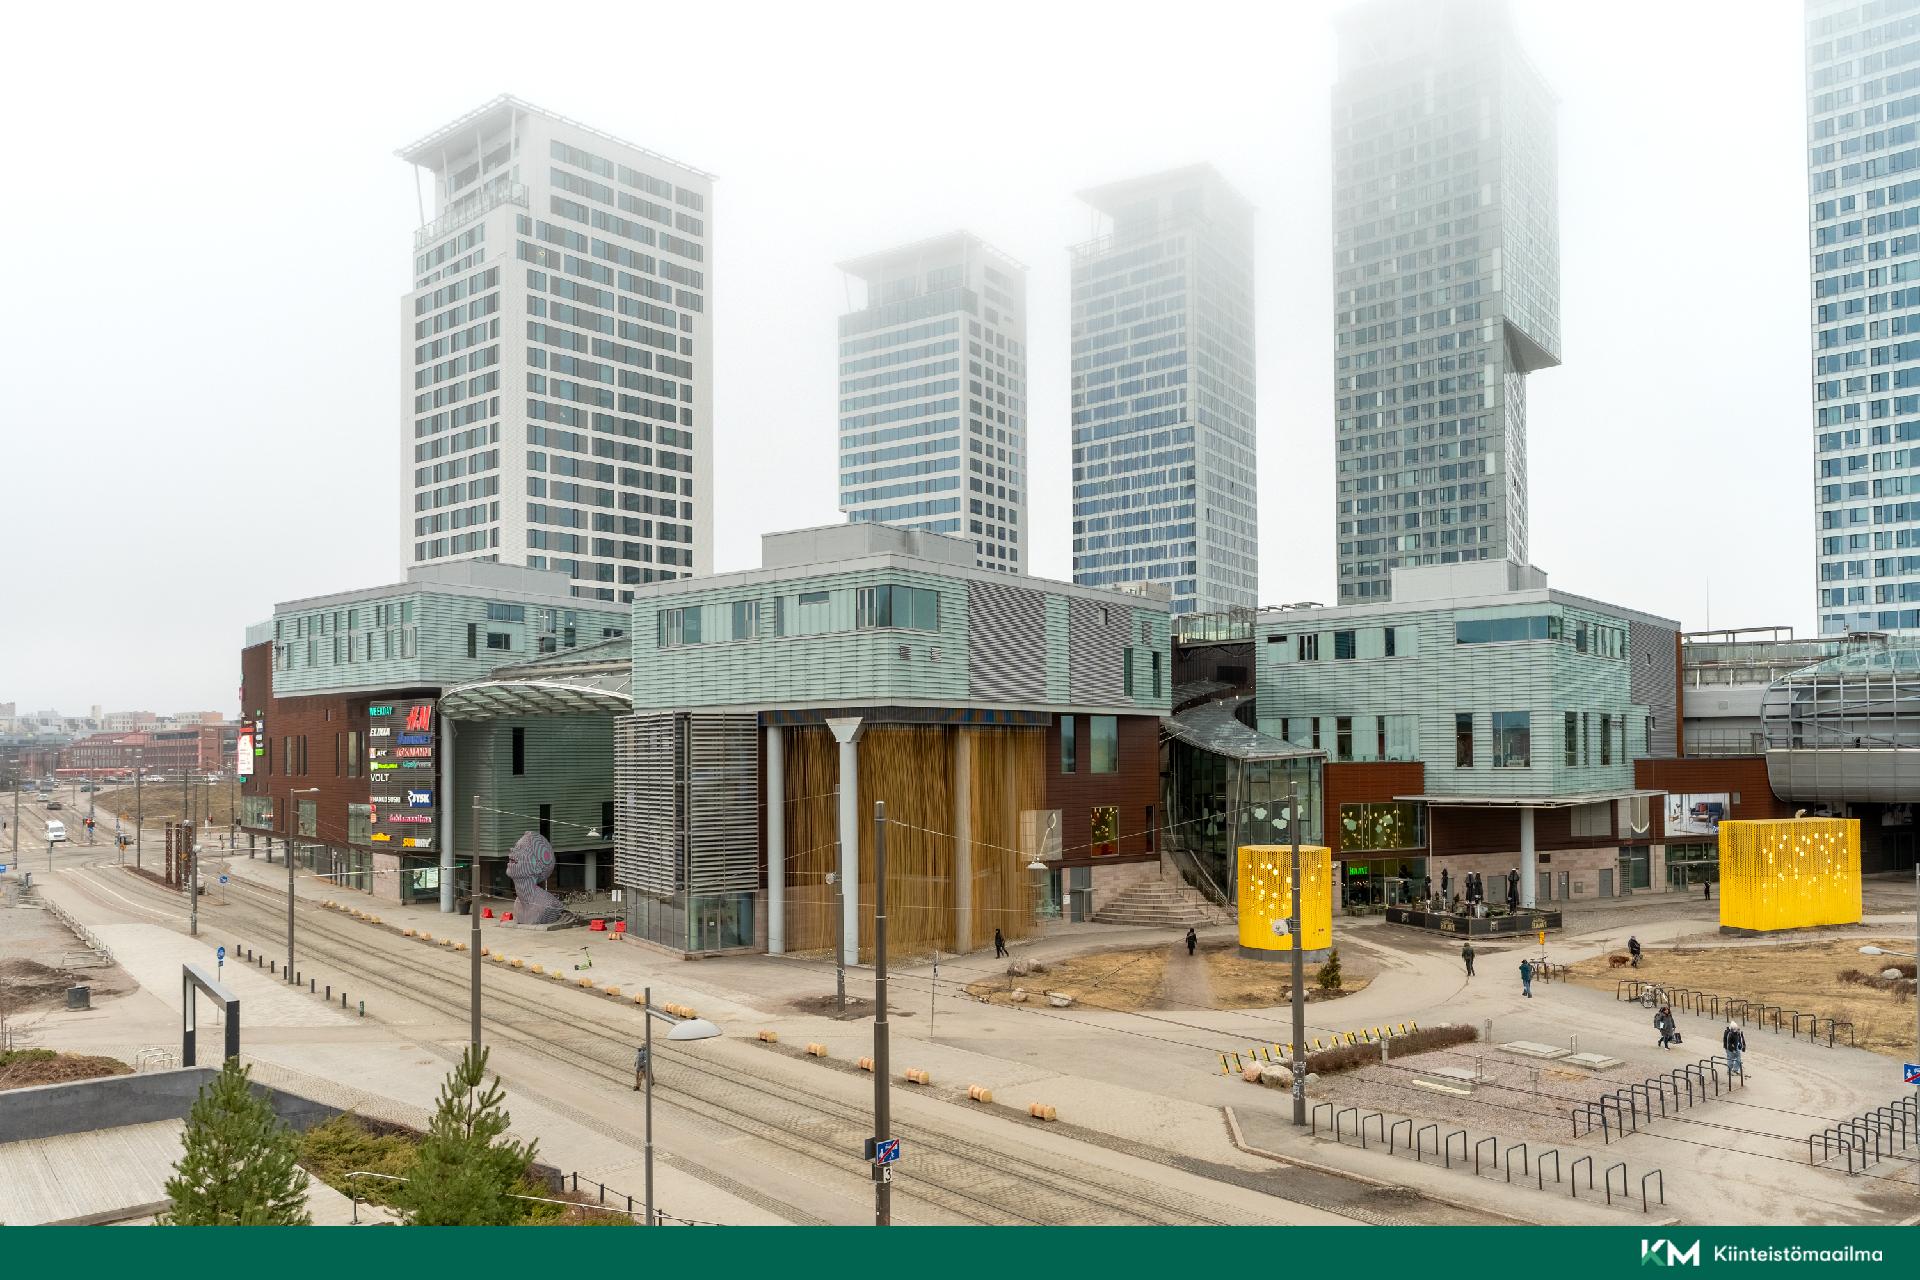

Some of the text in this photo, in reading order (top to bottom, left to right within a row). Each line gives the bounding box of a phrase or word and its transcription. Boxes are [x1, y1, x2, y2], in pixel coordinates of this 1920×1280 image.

[369, 705, 392, 716] WEEKDAY
[406, 704, 431, 731] H&M
[370, 773, 389, 781] VOLT
[411, 793, 430, 803] JYSK
[402, 837, 431, 847] SUBWAY
[885, 1167, 892, 1181] 3
